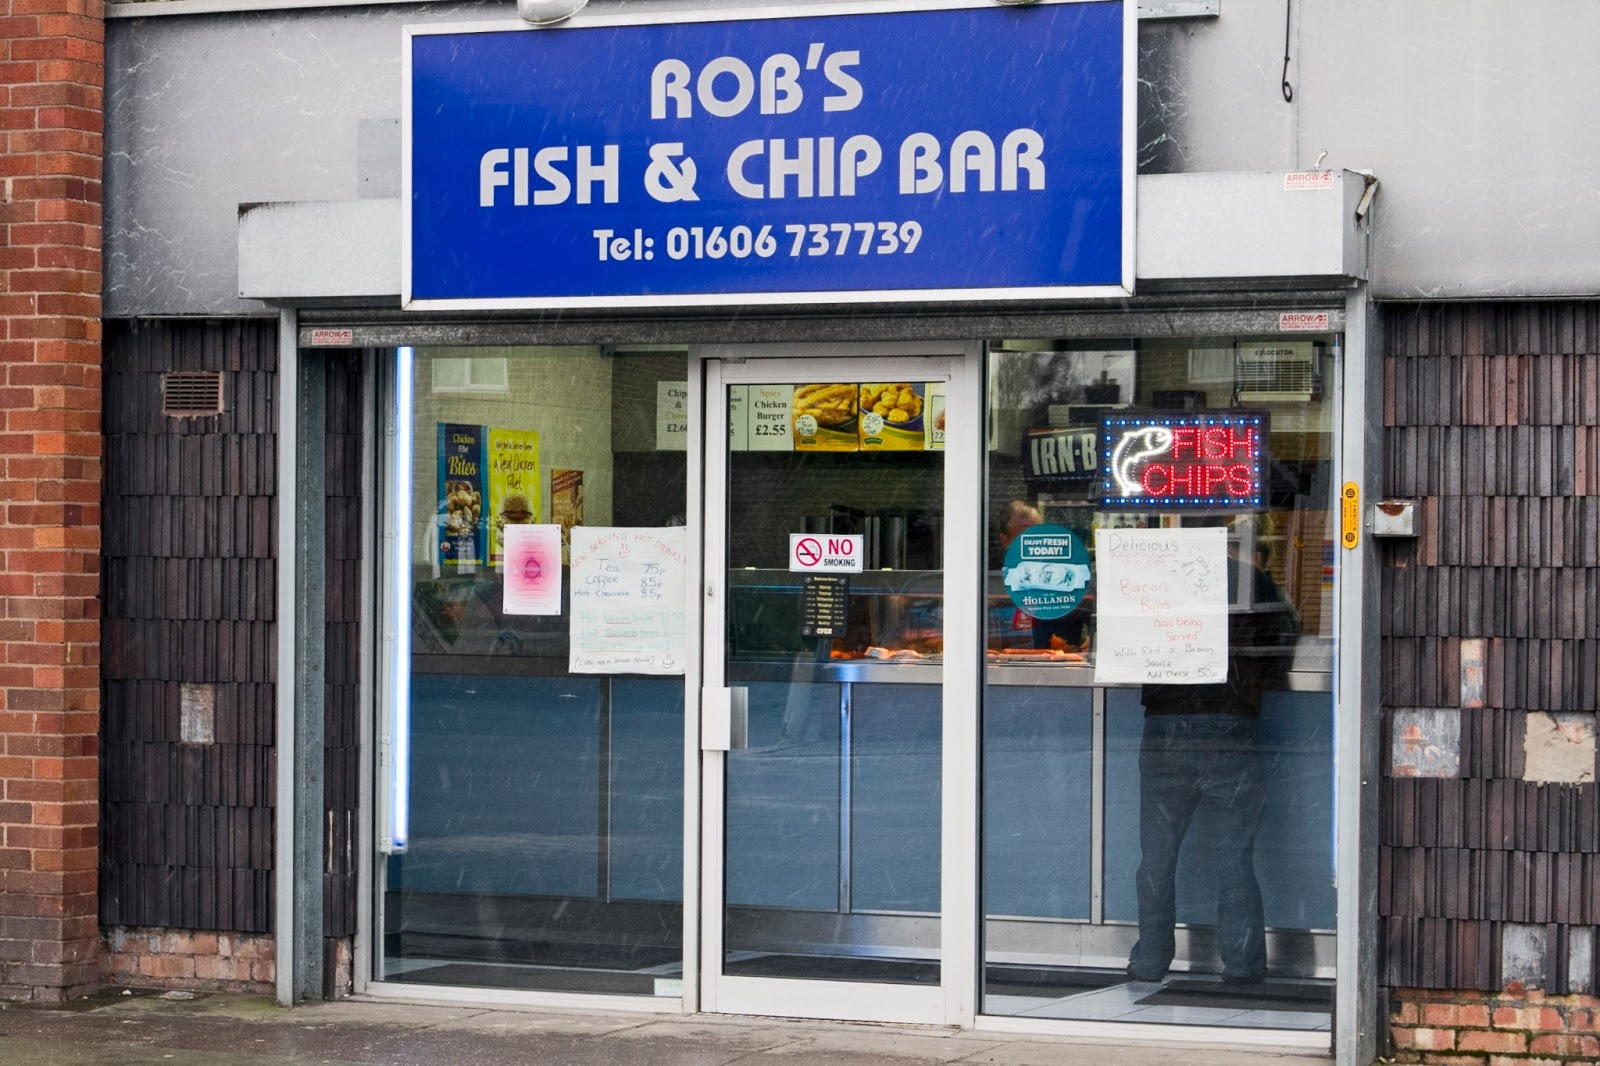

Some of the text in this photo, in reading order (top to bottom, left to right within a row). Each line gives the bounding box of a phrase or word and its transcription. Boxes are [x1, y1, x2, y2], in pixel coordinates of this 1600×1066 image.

[650, 43, 863, 119] ROB'S
[480, 129, 1046, 207] FISH & CHIP BAR
[1286, 173, 1320, 181] ARROW
[593, 220, 922, 261] Tel: 01606 737739
[1282, 314, 1314, 322] ARROW
[668, 389, 688, 399] Chip
[761, 389, 781, 399] Spicy
[754, 400, 787, 409] Chicken
[757, 412, 785, 421] Burger
[755, 424, 786, 436] £2.55
[453, 433, 475, 444] Chicken
[1172, 428, 1253, 459] FISH
[448, 455, 477, 476] Bites
[513, 453, 535, 471] Chicken
[1142, 464, 1253, 496] CHIPS
[635, 533, 654, 543] HOT
[1043, 538, 1068, 546] FRESH
[1109, 533, 1179, 552] Delicious
[829, 539, 853, 555] NO
[1028, 546, 1063, 555] TODAY!
[596, 558, 666, 576] Tea 75p
[823, 558, 856, 567] SMOKING
[641, 576, 663, 588] 85p
[1120, 578, 1168, 595] Bacon
[641, 588, 662, 600] 85p
[1140, 598, 1171, 614] Baps
[1176, 616, 1203, 632] being
[1141, 645, 1161, 656] Red
[1185, 643, 1214, 655] Brown
[1144, 658, 1172, 668] Sauce
[1147, 670, 1162, 679] Add
[1197, 667, 1218, 679] 50p
